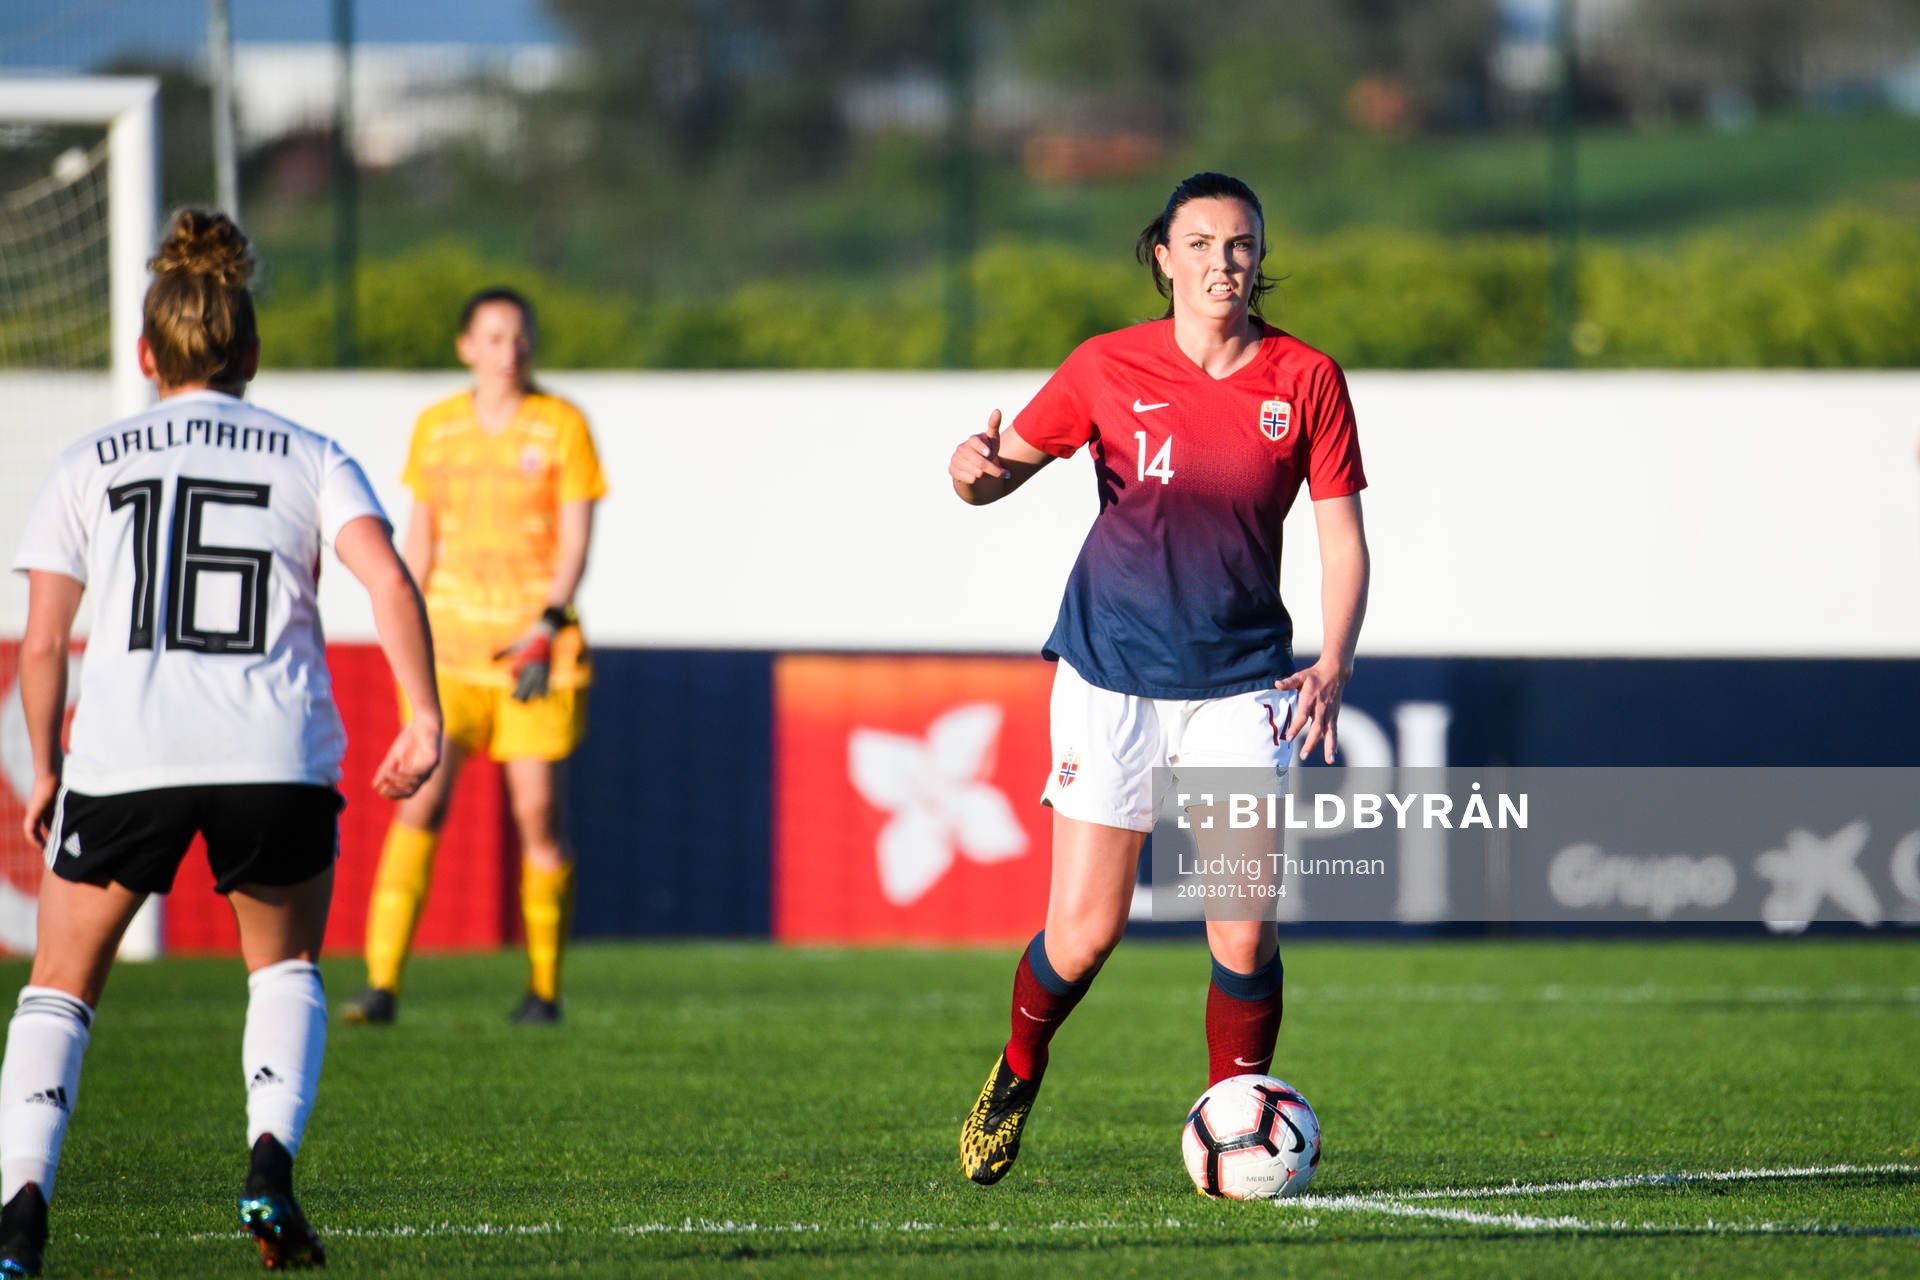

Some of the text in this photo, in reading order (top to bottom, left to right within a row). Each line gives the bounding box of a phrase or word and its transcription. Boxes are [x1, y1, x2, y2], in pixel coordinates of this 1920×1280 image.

[96, 418, 290, 465] DALLMANN
[1134, 431, 1175, 485] 14
[107, 475, 272, 656] 16
